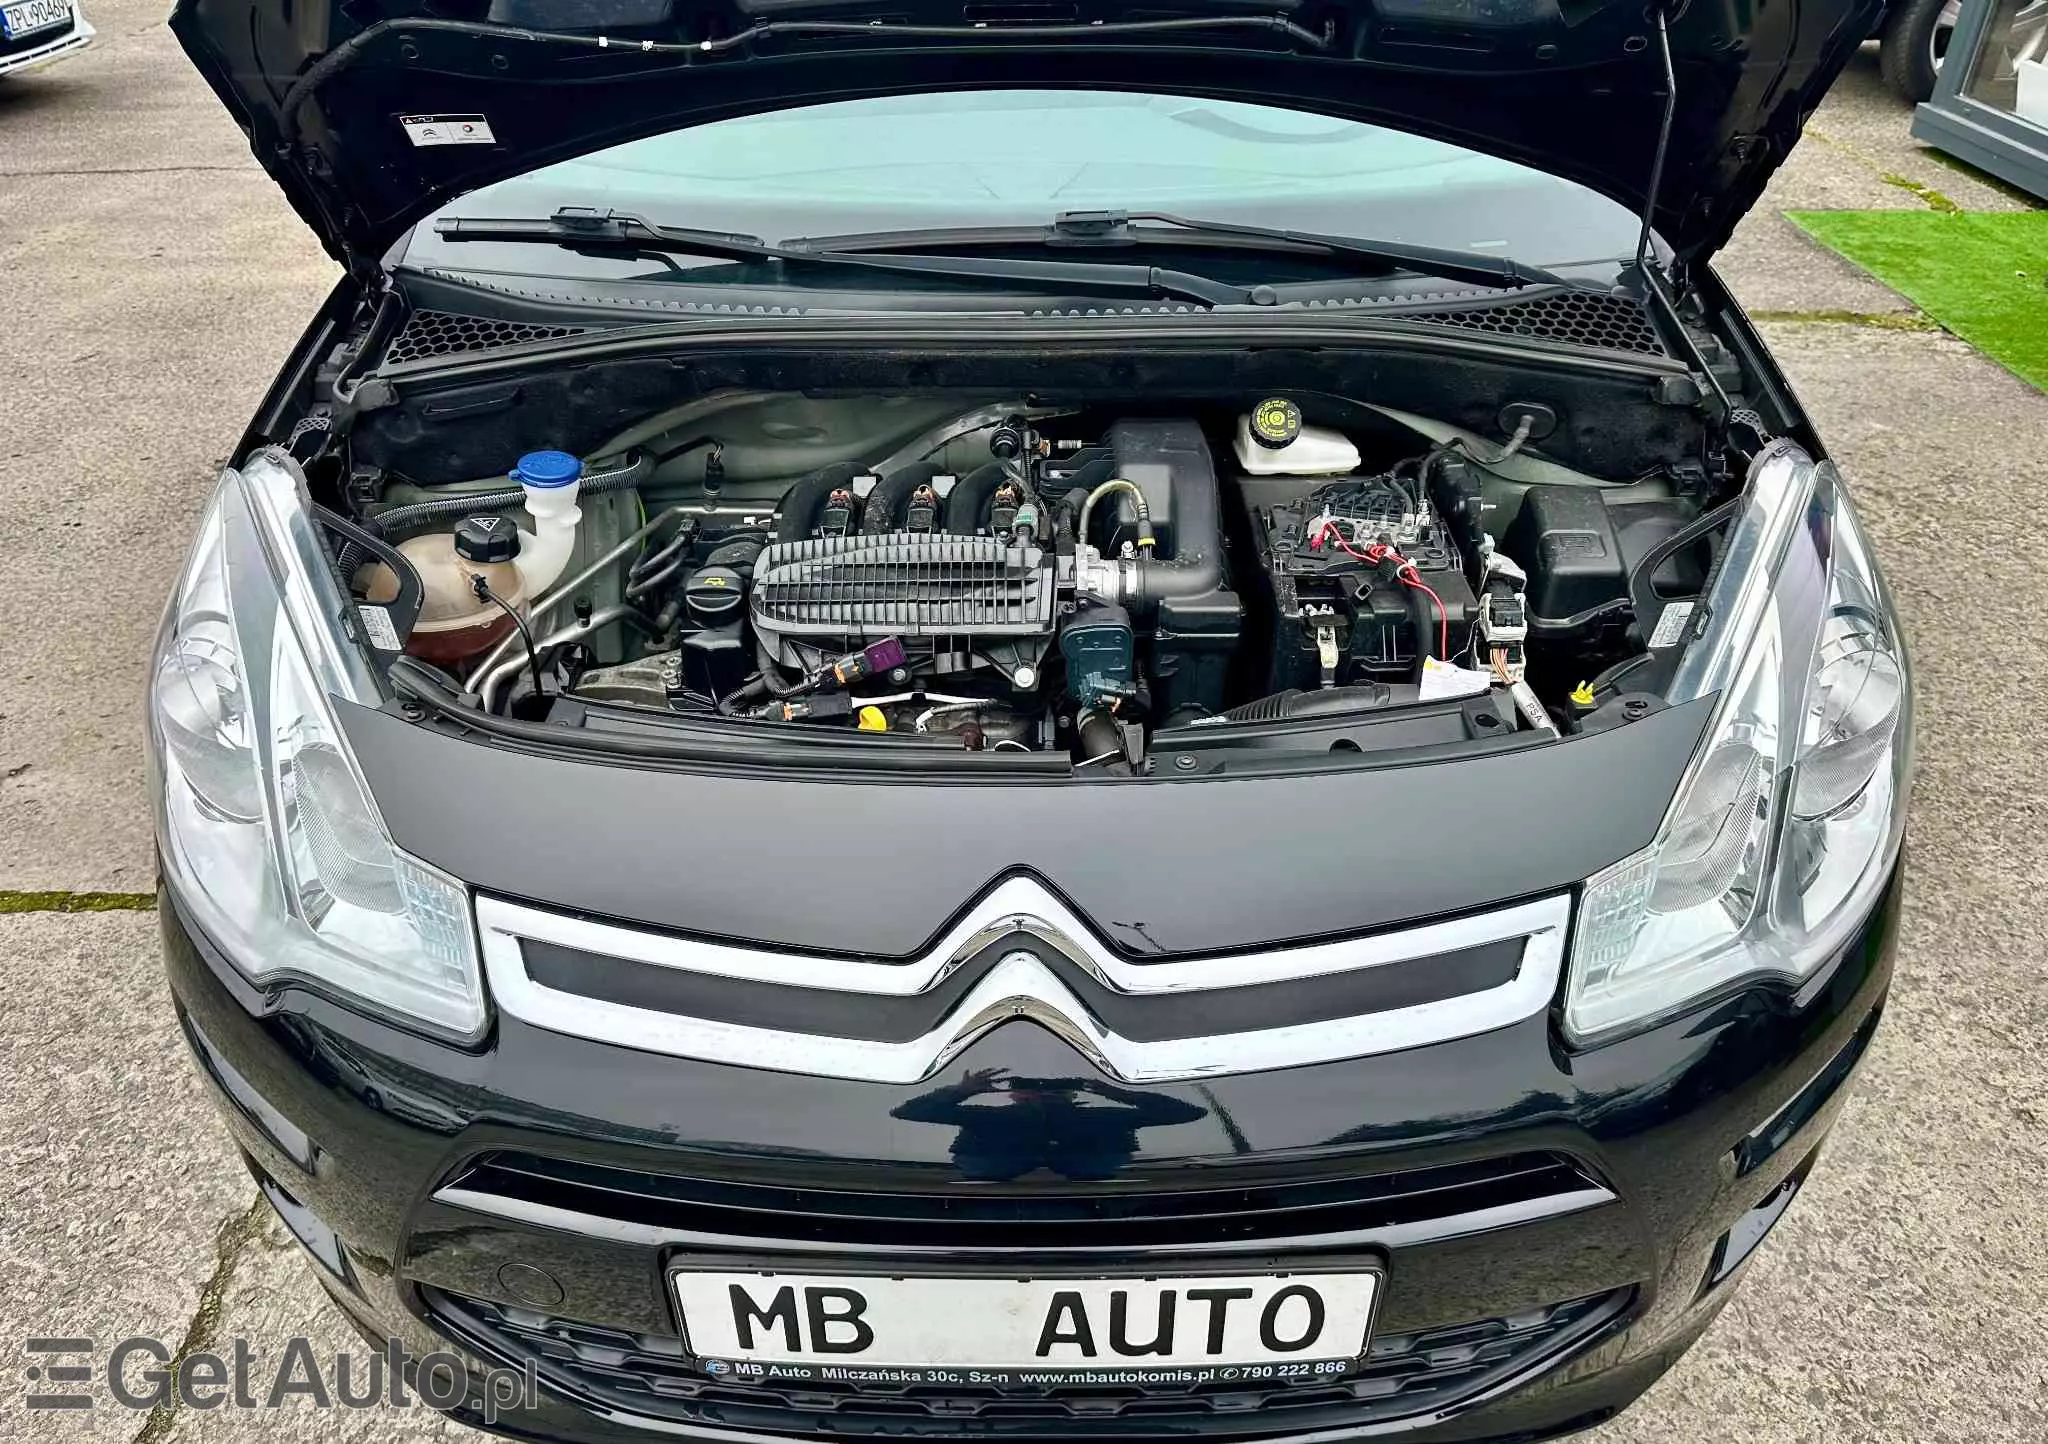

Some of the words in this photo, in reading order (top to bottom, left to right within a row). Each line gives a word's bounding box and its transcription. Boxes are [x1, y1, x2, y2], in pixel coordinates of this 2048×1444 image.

[6, 8, 33, 32] ZPL
[728, 1283, 875, 1355] MB
[1035, 1283, 1327, 1358] AUTO
[734, 1362, 764, 1376] MB
[769, 1365, 811, 1378] Auto
[821, 1367, 922, 1382] Milczańska
[927, 1370, 963, 1384] 30c,
[969, 1371, 1009, 1383] Sz-n
[1019, 1367, 1215, 1384] www.mbautokomis.pl
[1241, 1366, 1272, 1379] 790
[1277, 1364, 1309, 1377] 222
[1314, 1360, 1346, 1374] 866
